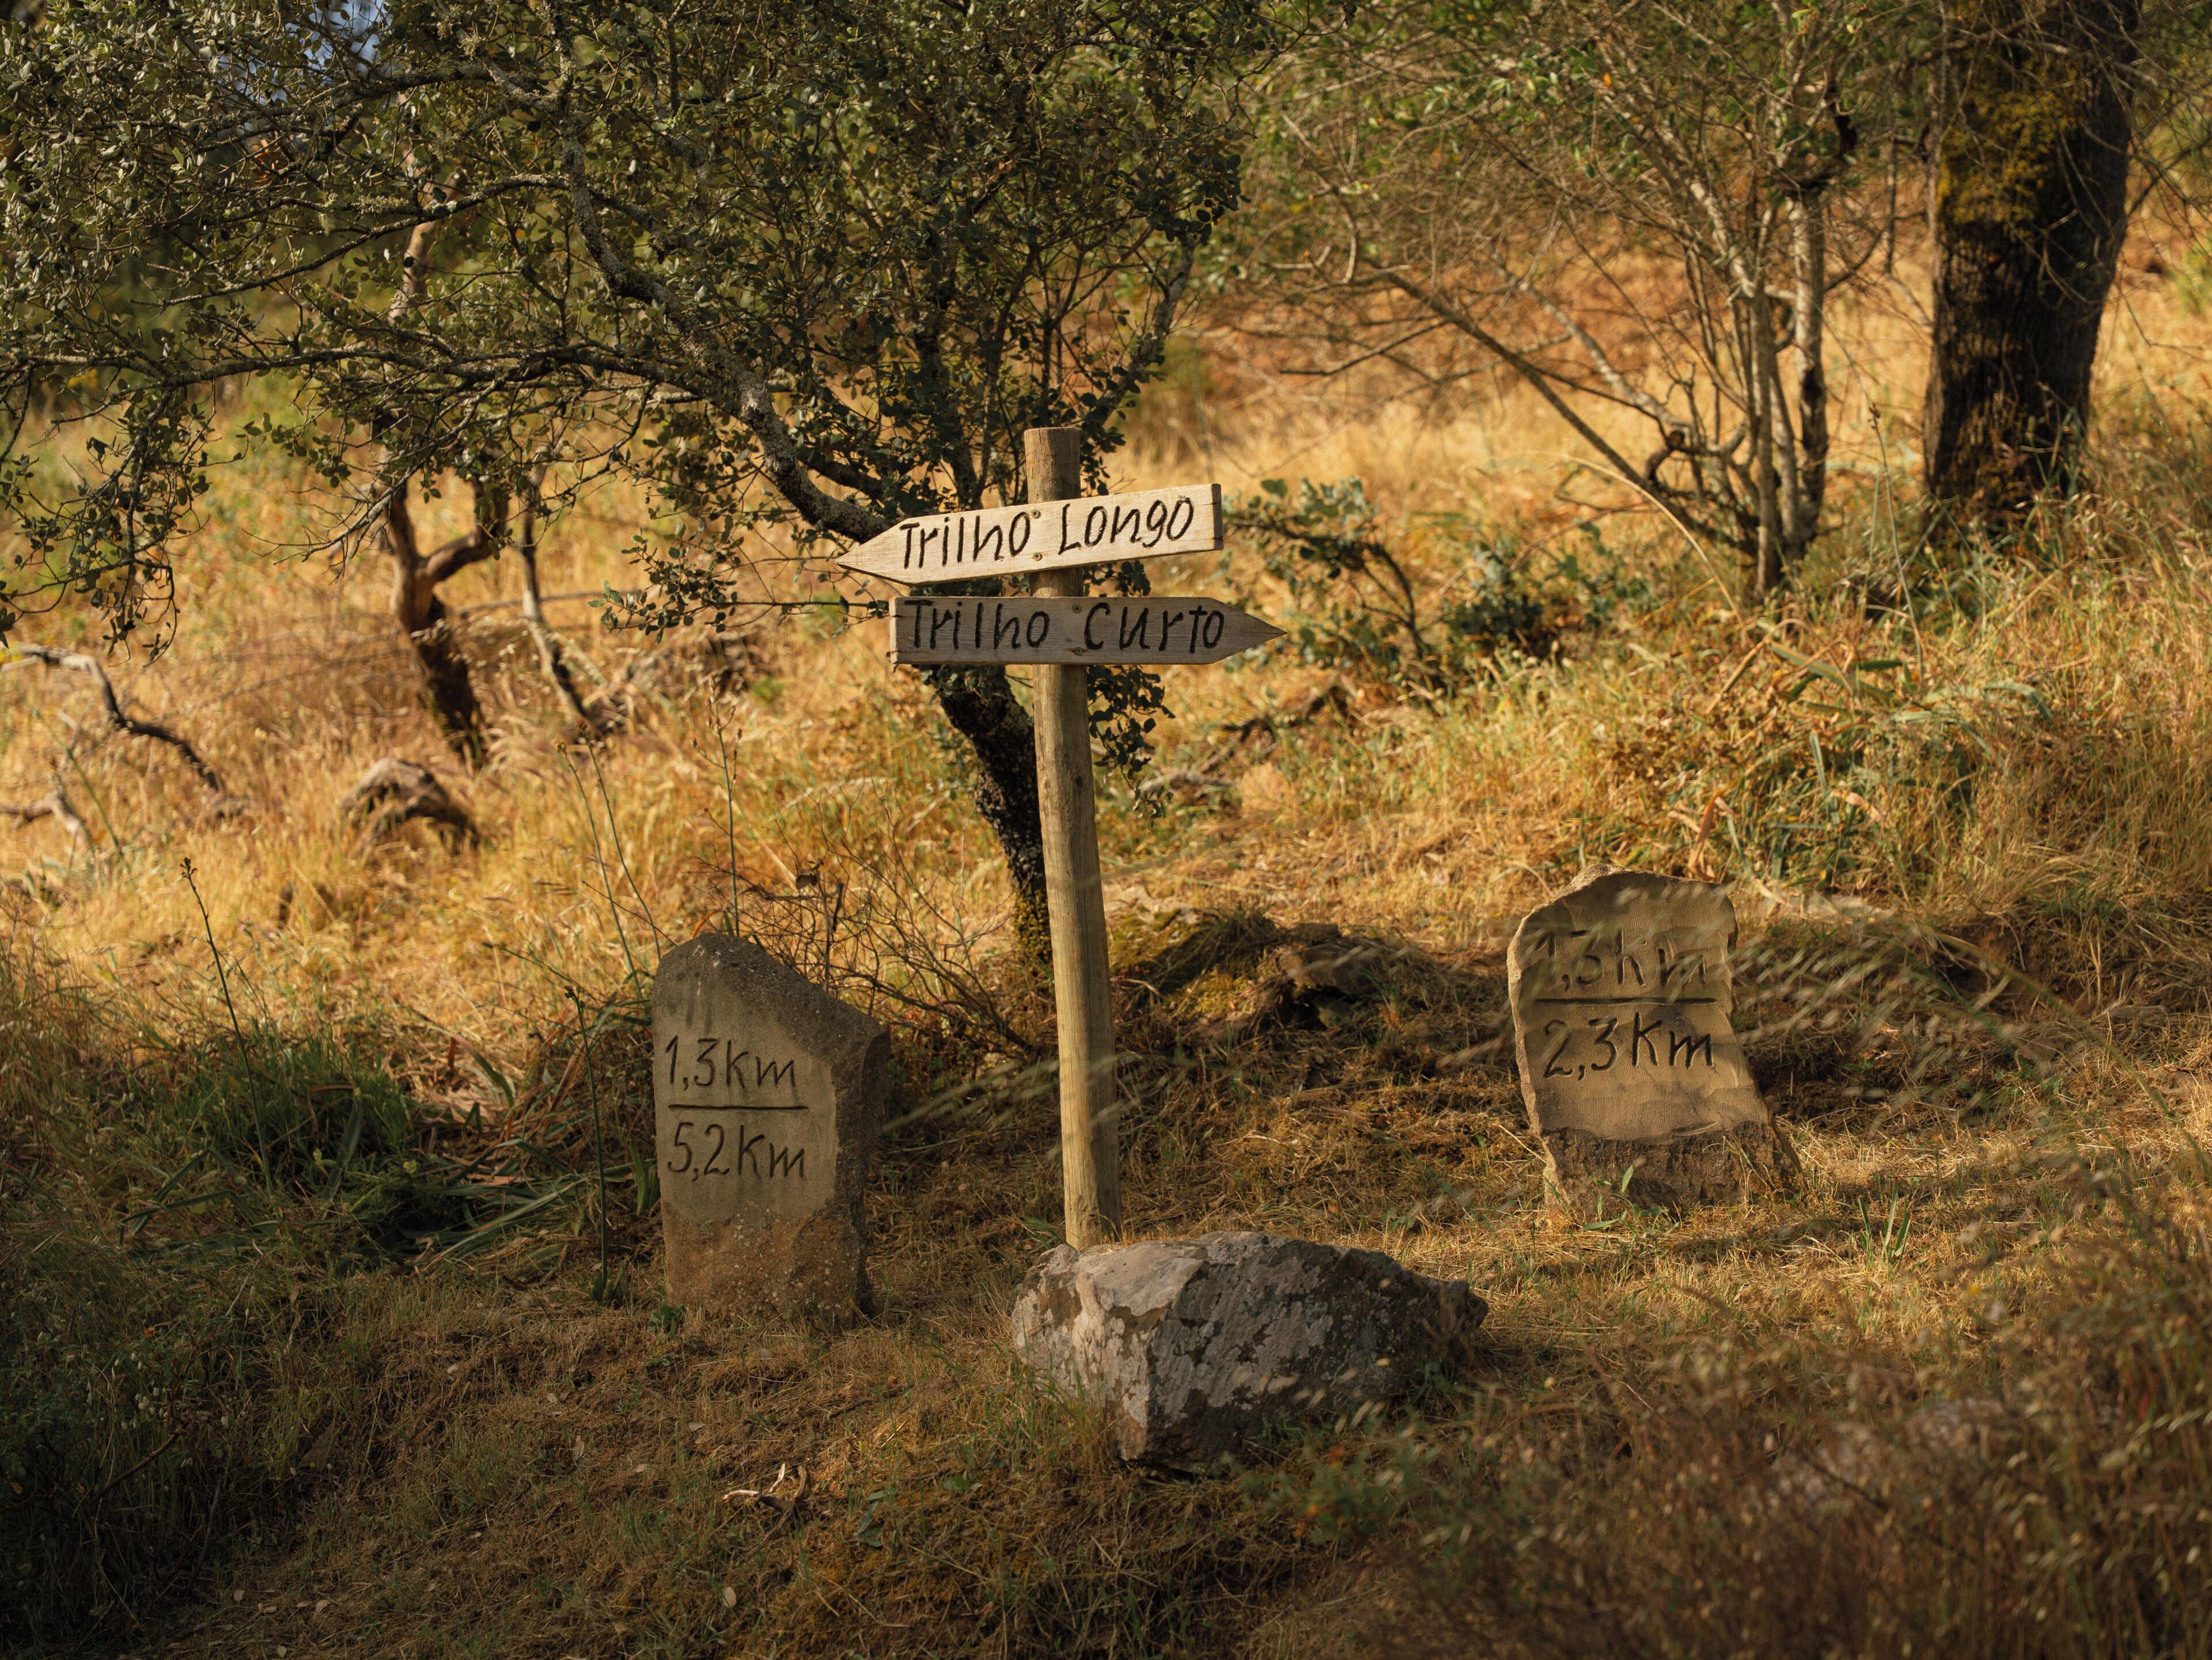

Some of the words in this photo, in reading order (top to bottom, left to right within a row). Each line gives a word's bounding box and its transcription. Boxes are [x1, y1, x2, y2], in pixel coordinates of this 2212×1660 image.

[900, 510, 1032, 570] Trilho
[1059, 498, 1196, 556] Longo
[904, 599, 1051, 650] Trilho
[1084, 601, 1226, 655] Curto
